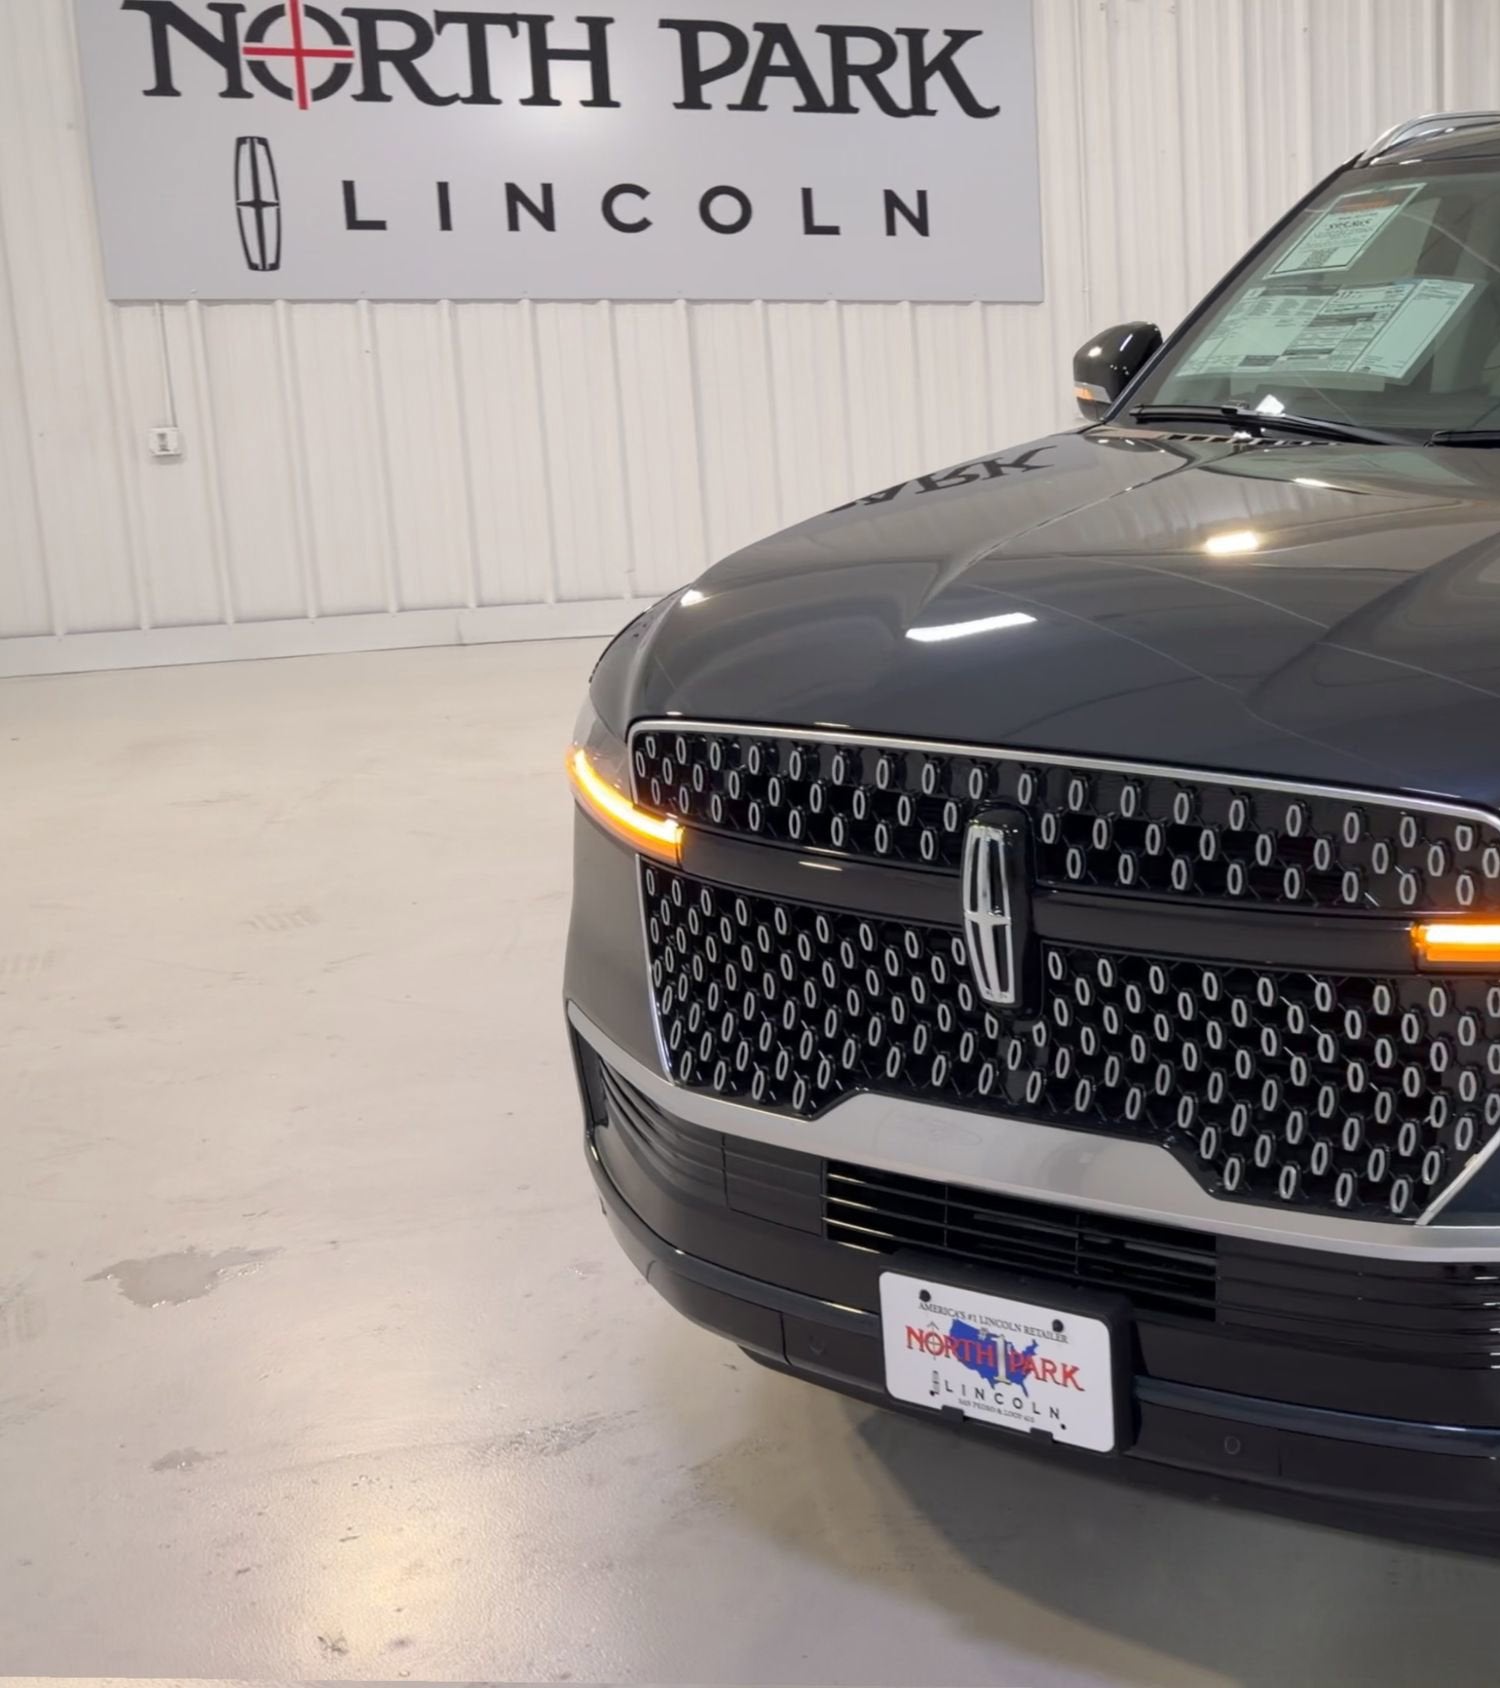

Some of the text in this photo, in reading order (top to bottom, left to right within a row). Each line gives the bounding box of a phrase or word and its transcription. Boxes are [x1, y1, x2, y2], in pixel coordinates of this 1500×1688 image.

[121, 0, 1001, 119] NORTH PARK
[342, 180, 930, 237] LINCOLN
[918, 1302, 966, 1320] AMERICA'S
[979, 1315, 1022, 1333] LINCOLN
[1024, 1325, 1069, 1344] RETAILER
[905, 1325, 1086, 1392] NORTH PARK
[944, 1379, 1060, 1420] LINCOLN
